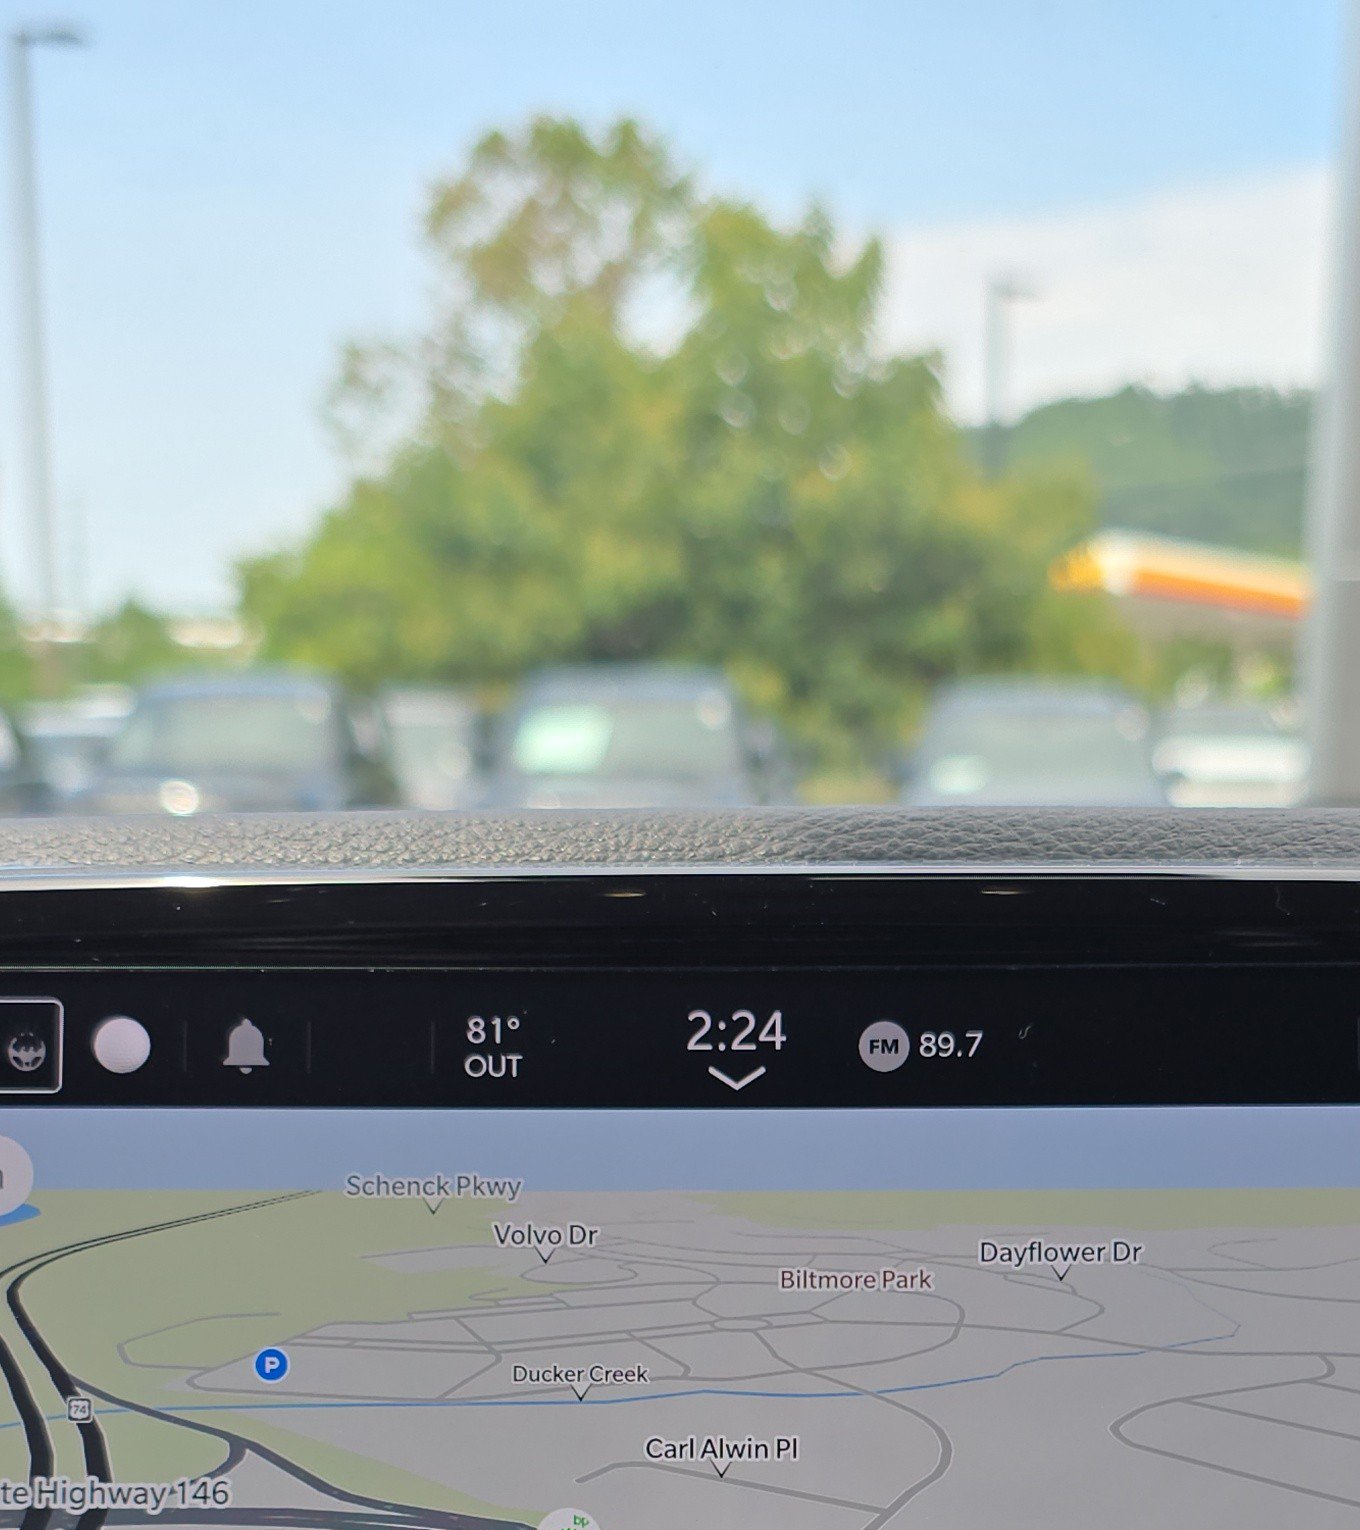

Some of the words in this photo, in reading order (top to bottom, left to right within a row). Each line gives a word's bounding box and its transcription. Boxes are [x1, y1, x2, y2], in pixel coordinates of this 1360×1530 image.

[686, 1009, 787, 1052] 2:24
[869, 1038, 900, 1055] FM
[918, 1032, 984, 1058] 89.7
[464, 1055, 523, 1079] OUT
[345, 1174, 450, 1198] Schenck
[456, 1175, 522, 1202] Pkwy
[493, 1224, 563, 1246] Volvo
[569, 1224, 598, 1246] Dr
[979, 1241, 1106, 1269] Dayflower
[1110, 1242, 1143, 1264] Dr
[780, 1269, 875, 1291] Biltmore
[879, 1270, 932, 1291] Park
[512, 1364, 584, 1384] Ducker
[588, 1364, 649, 1384] Creek
[645, 1438, 695, 1459] Carl
[700, 1438, 769, 1459] Alwin
[775, 1438, 798, 1459] Pl
[37, 1480, 167, 1510] Highway
[177, 1481, 230, 1504] 146
